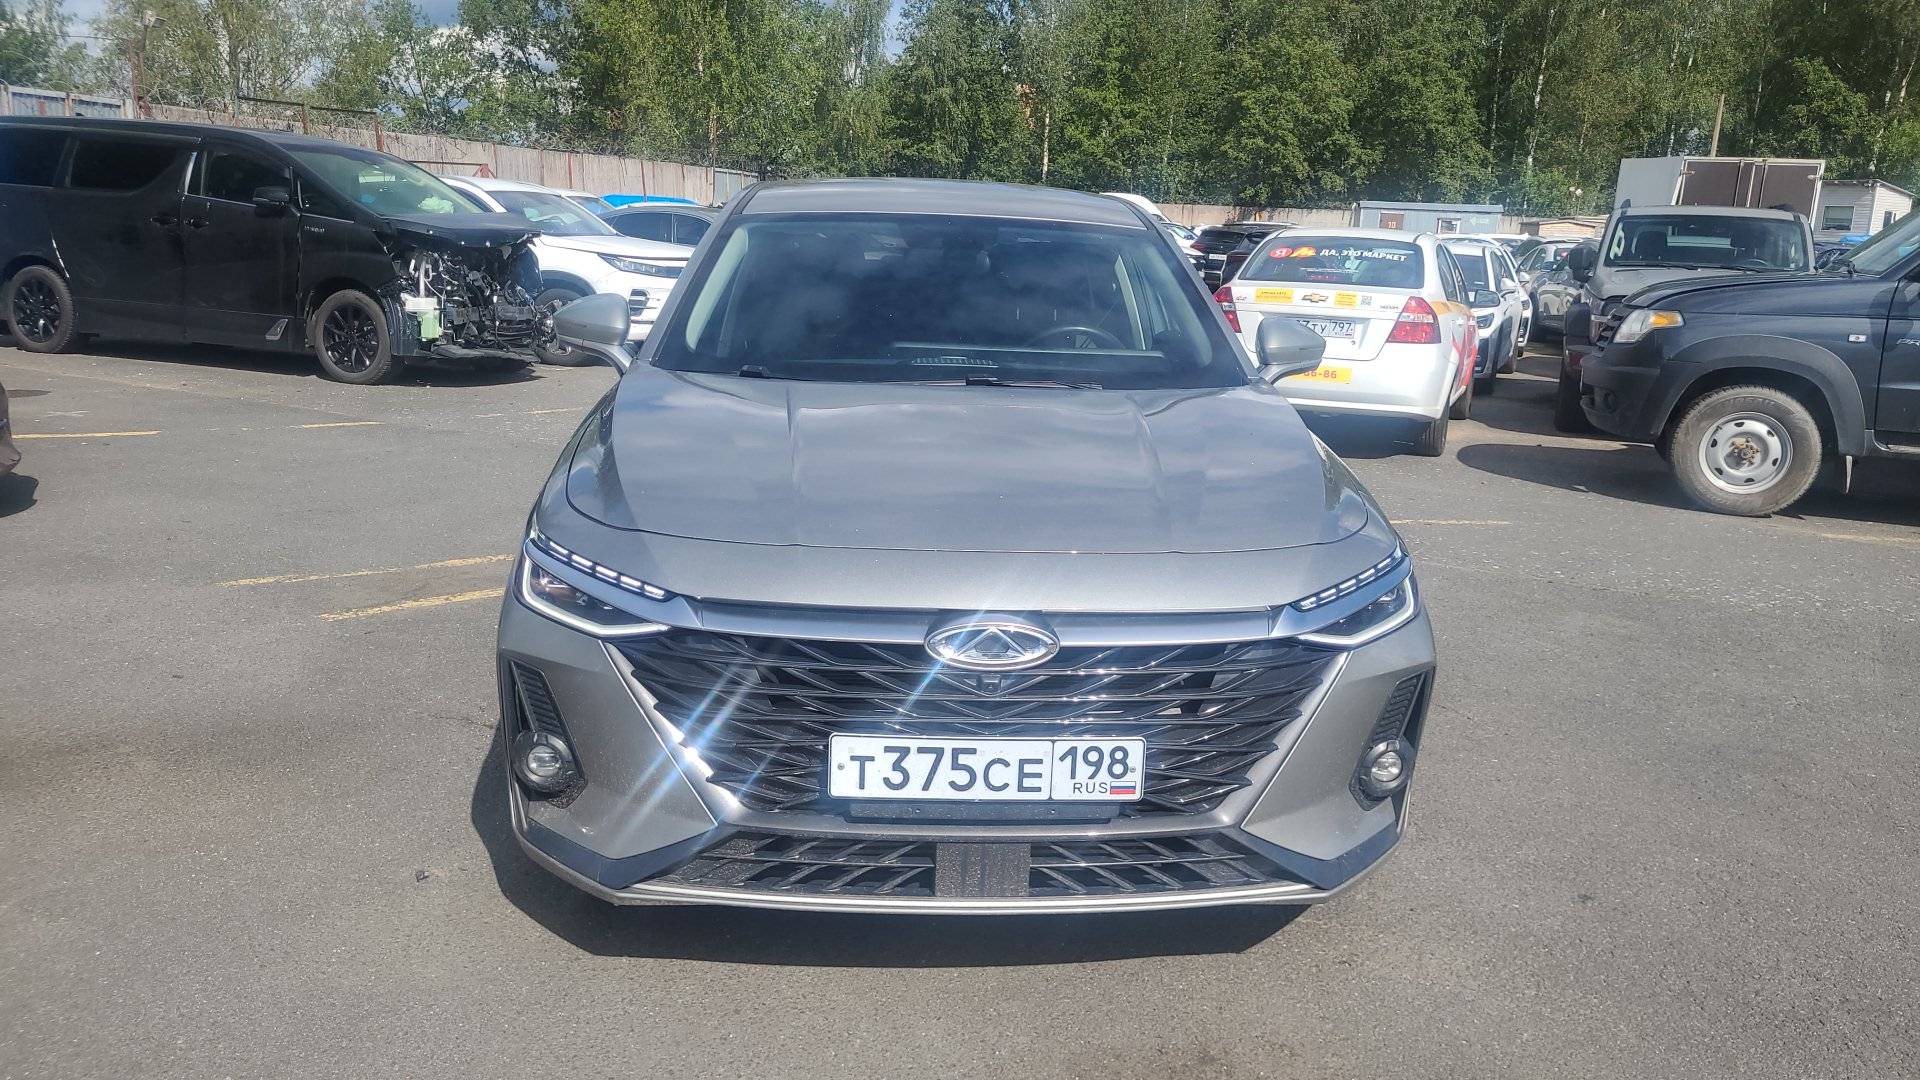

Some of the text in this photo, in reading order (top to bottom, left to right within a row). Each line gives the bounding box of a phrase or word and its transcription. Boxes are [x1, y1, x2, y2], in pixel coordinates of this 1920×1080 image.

[1320, 249, 1339, 257] ДА,
[1341, 249, 1360, 257] ЭТО
[1362, 251, 1407, 261] МАРКЕТ
[1331, 321, 1352, 332] 797
[850, 745, 1129, 793] Т375СЕ 198
[1073, 782, 1108, 794] RUS
